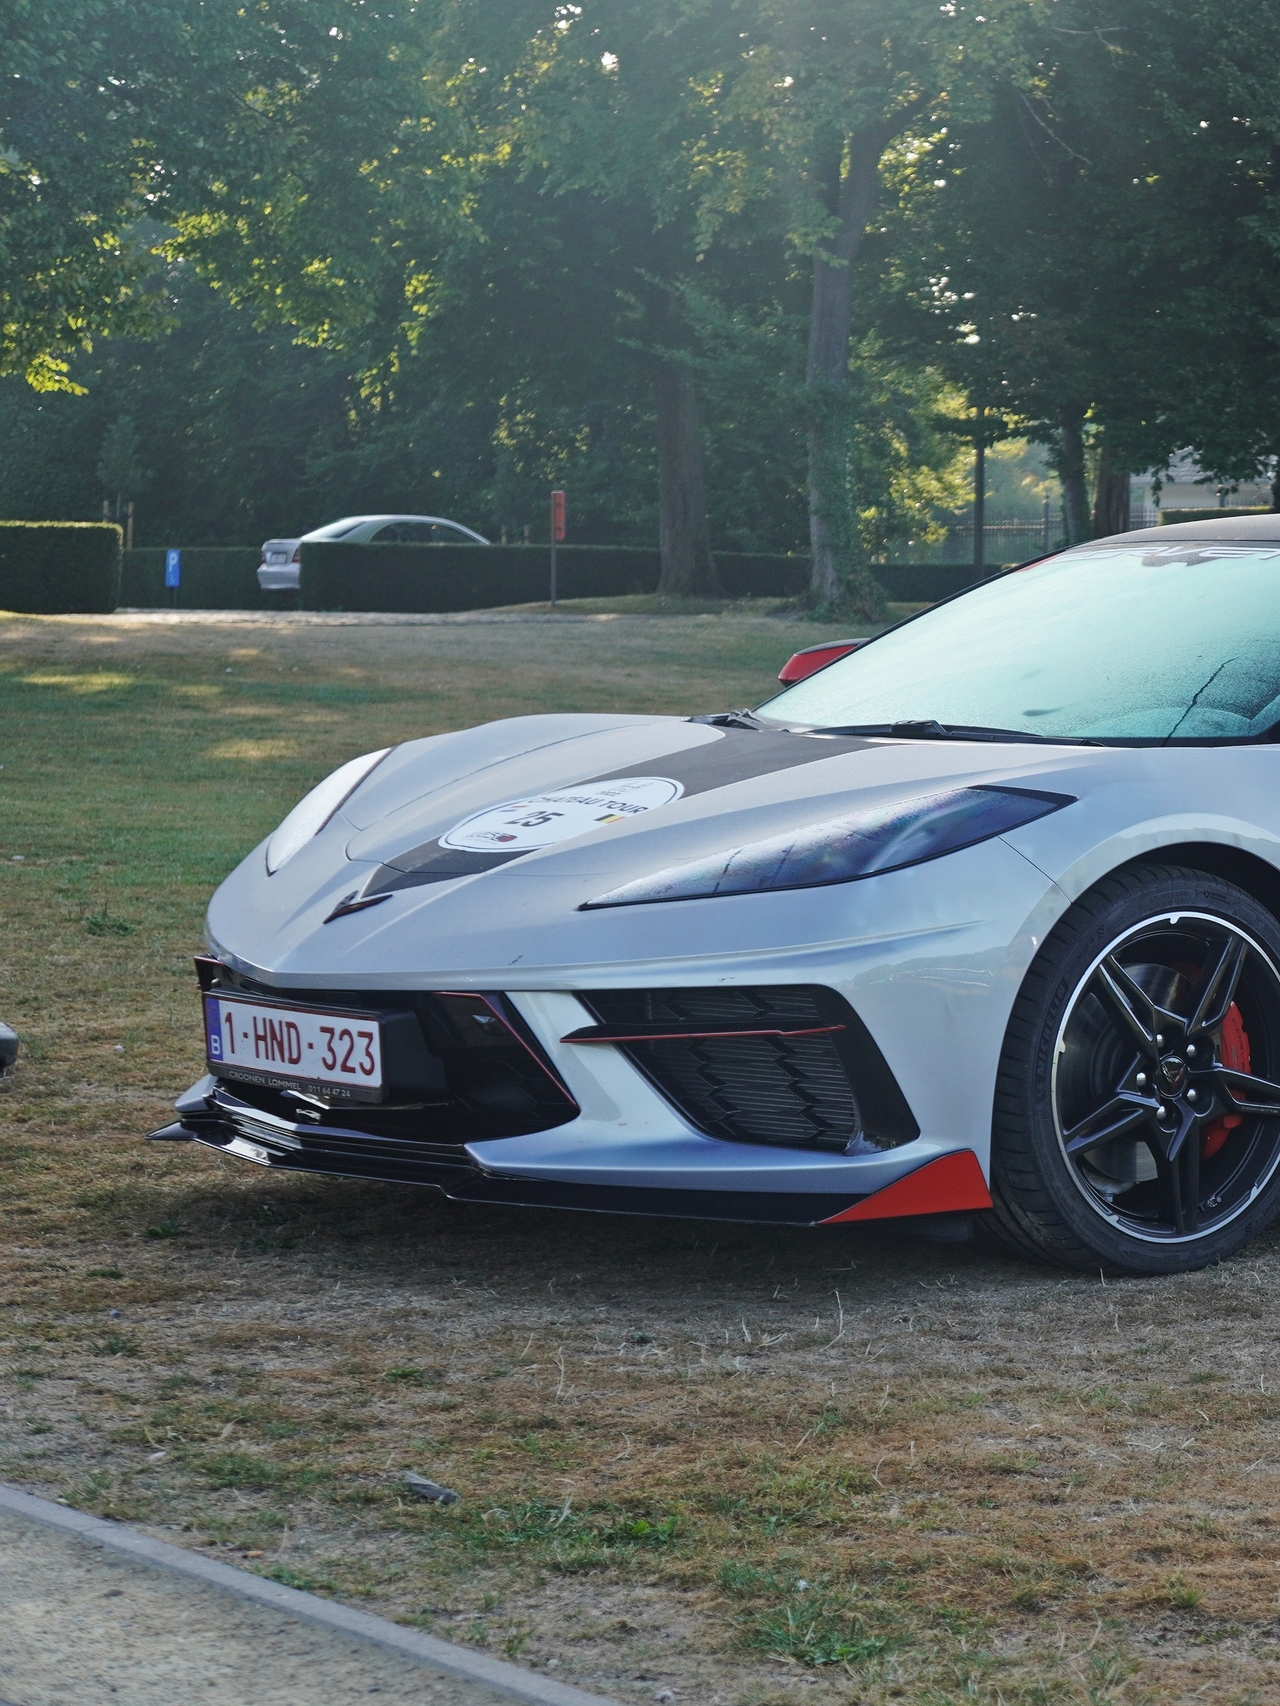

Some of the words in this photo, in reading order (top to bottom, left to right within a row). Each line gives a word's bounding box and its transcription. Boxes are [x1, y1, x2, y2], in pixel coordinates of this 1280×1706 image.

[502, 810, 566, 827] 25
[597, 800, 649, 814] TOUR
[1036, 981, 1068, 1077] MICHELIN
[210, 1034, 220, 1055] B
[224, 1011, 375, 1076] 1-HND-323
[228, 1070, 265, 1084] CROONEN
[268, 1078, 302, 1091] LOMMEL
[308, 1084, 320, 1093] 011
[322, 1087, 331, 1095] 64
[331, 1088, 340, 1096] 47
[341, 1089, 351, 1098] 24
